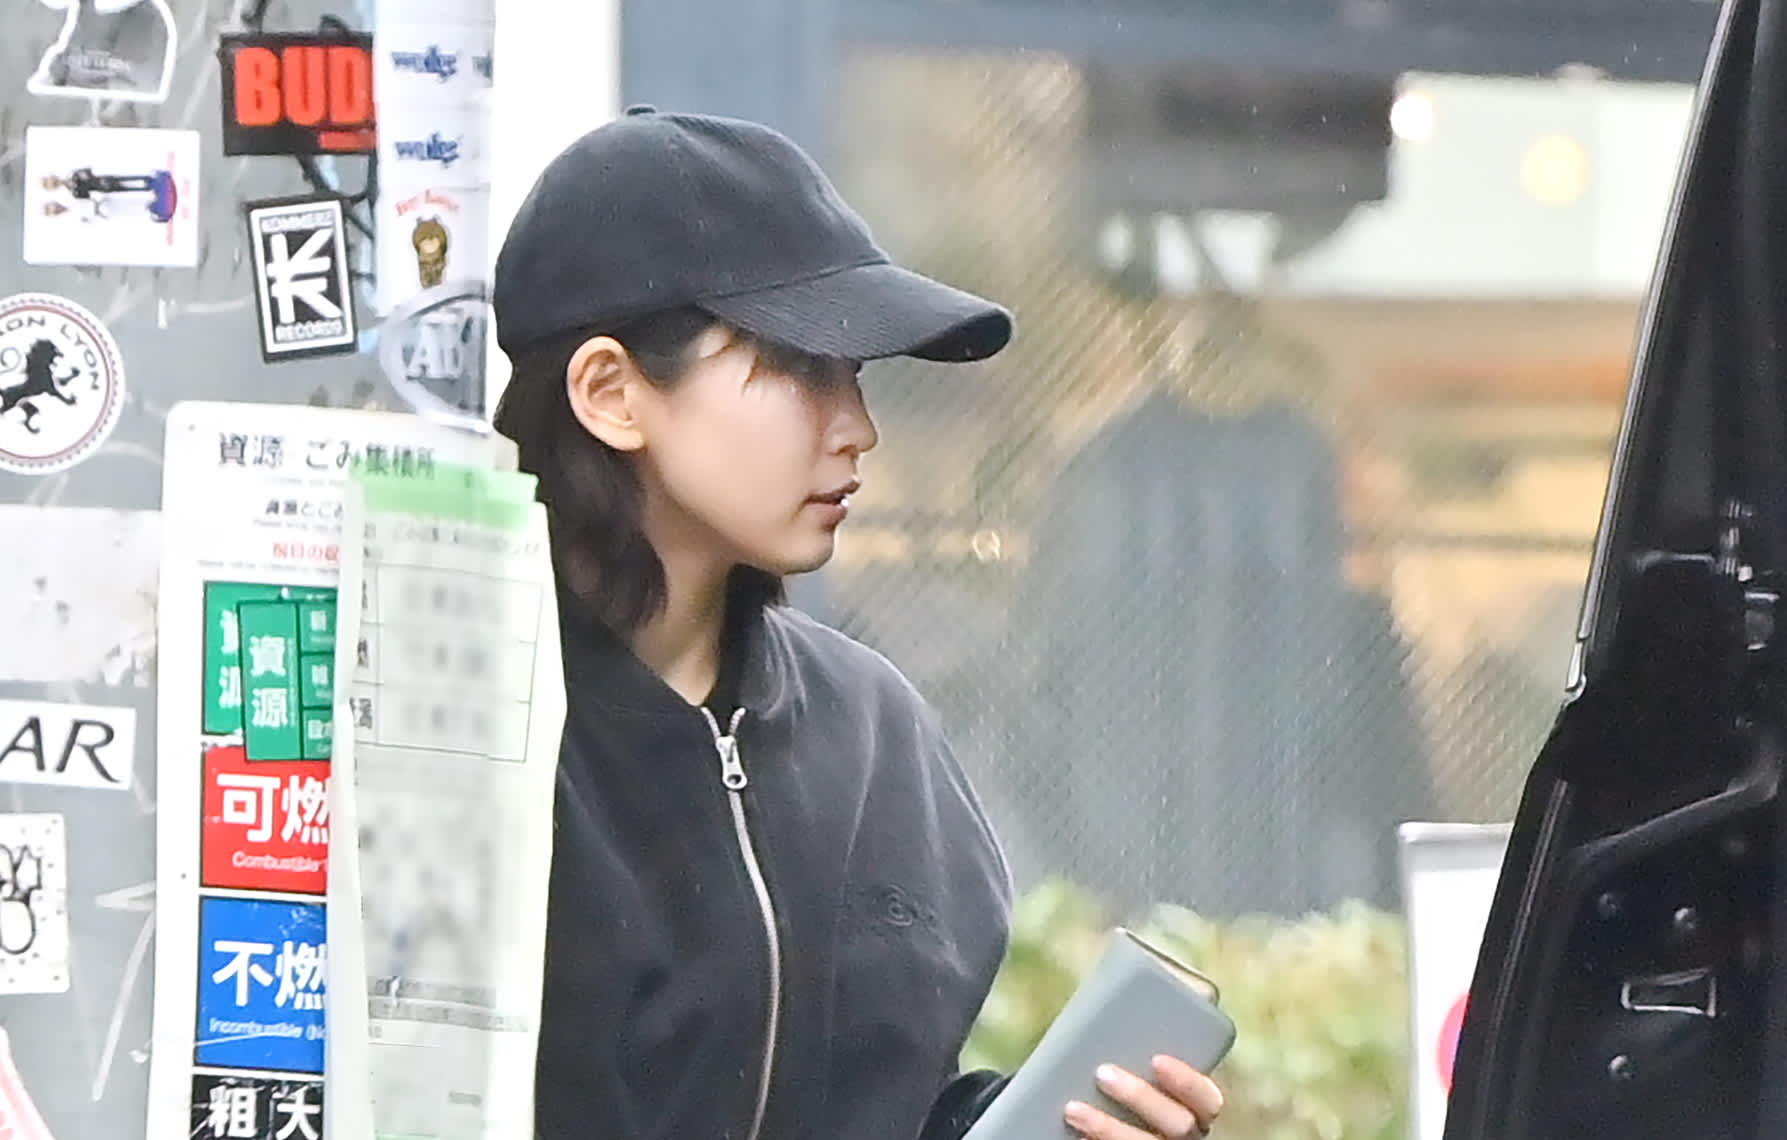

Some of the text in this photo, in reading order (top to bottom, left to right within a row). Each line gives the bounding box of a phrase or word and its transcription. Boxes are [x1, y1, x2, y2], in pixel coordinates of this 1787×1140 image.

[59, 323, 100, 392] LYON
[250, 635, 289, 728] 資源
[0, 716, 122, 784] AR
[216, 772, 329, 845] 可燃
[212, 940, 326, 1010] 不燃
